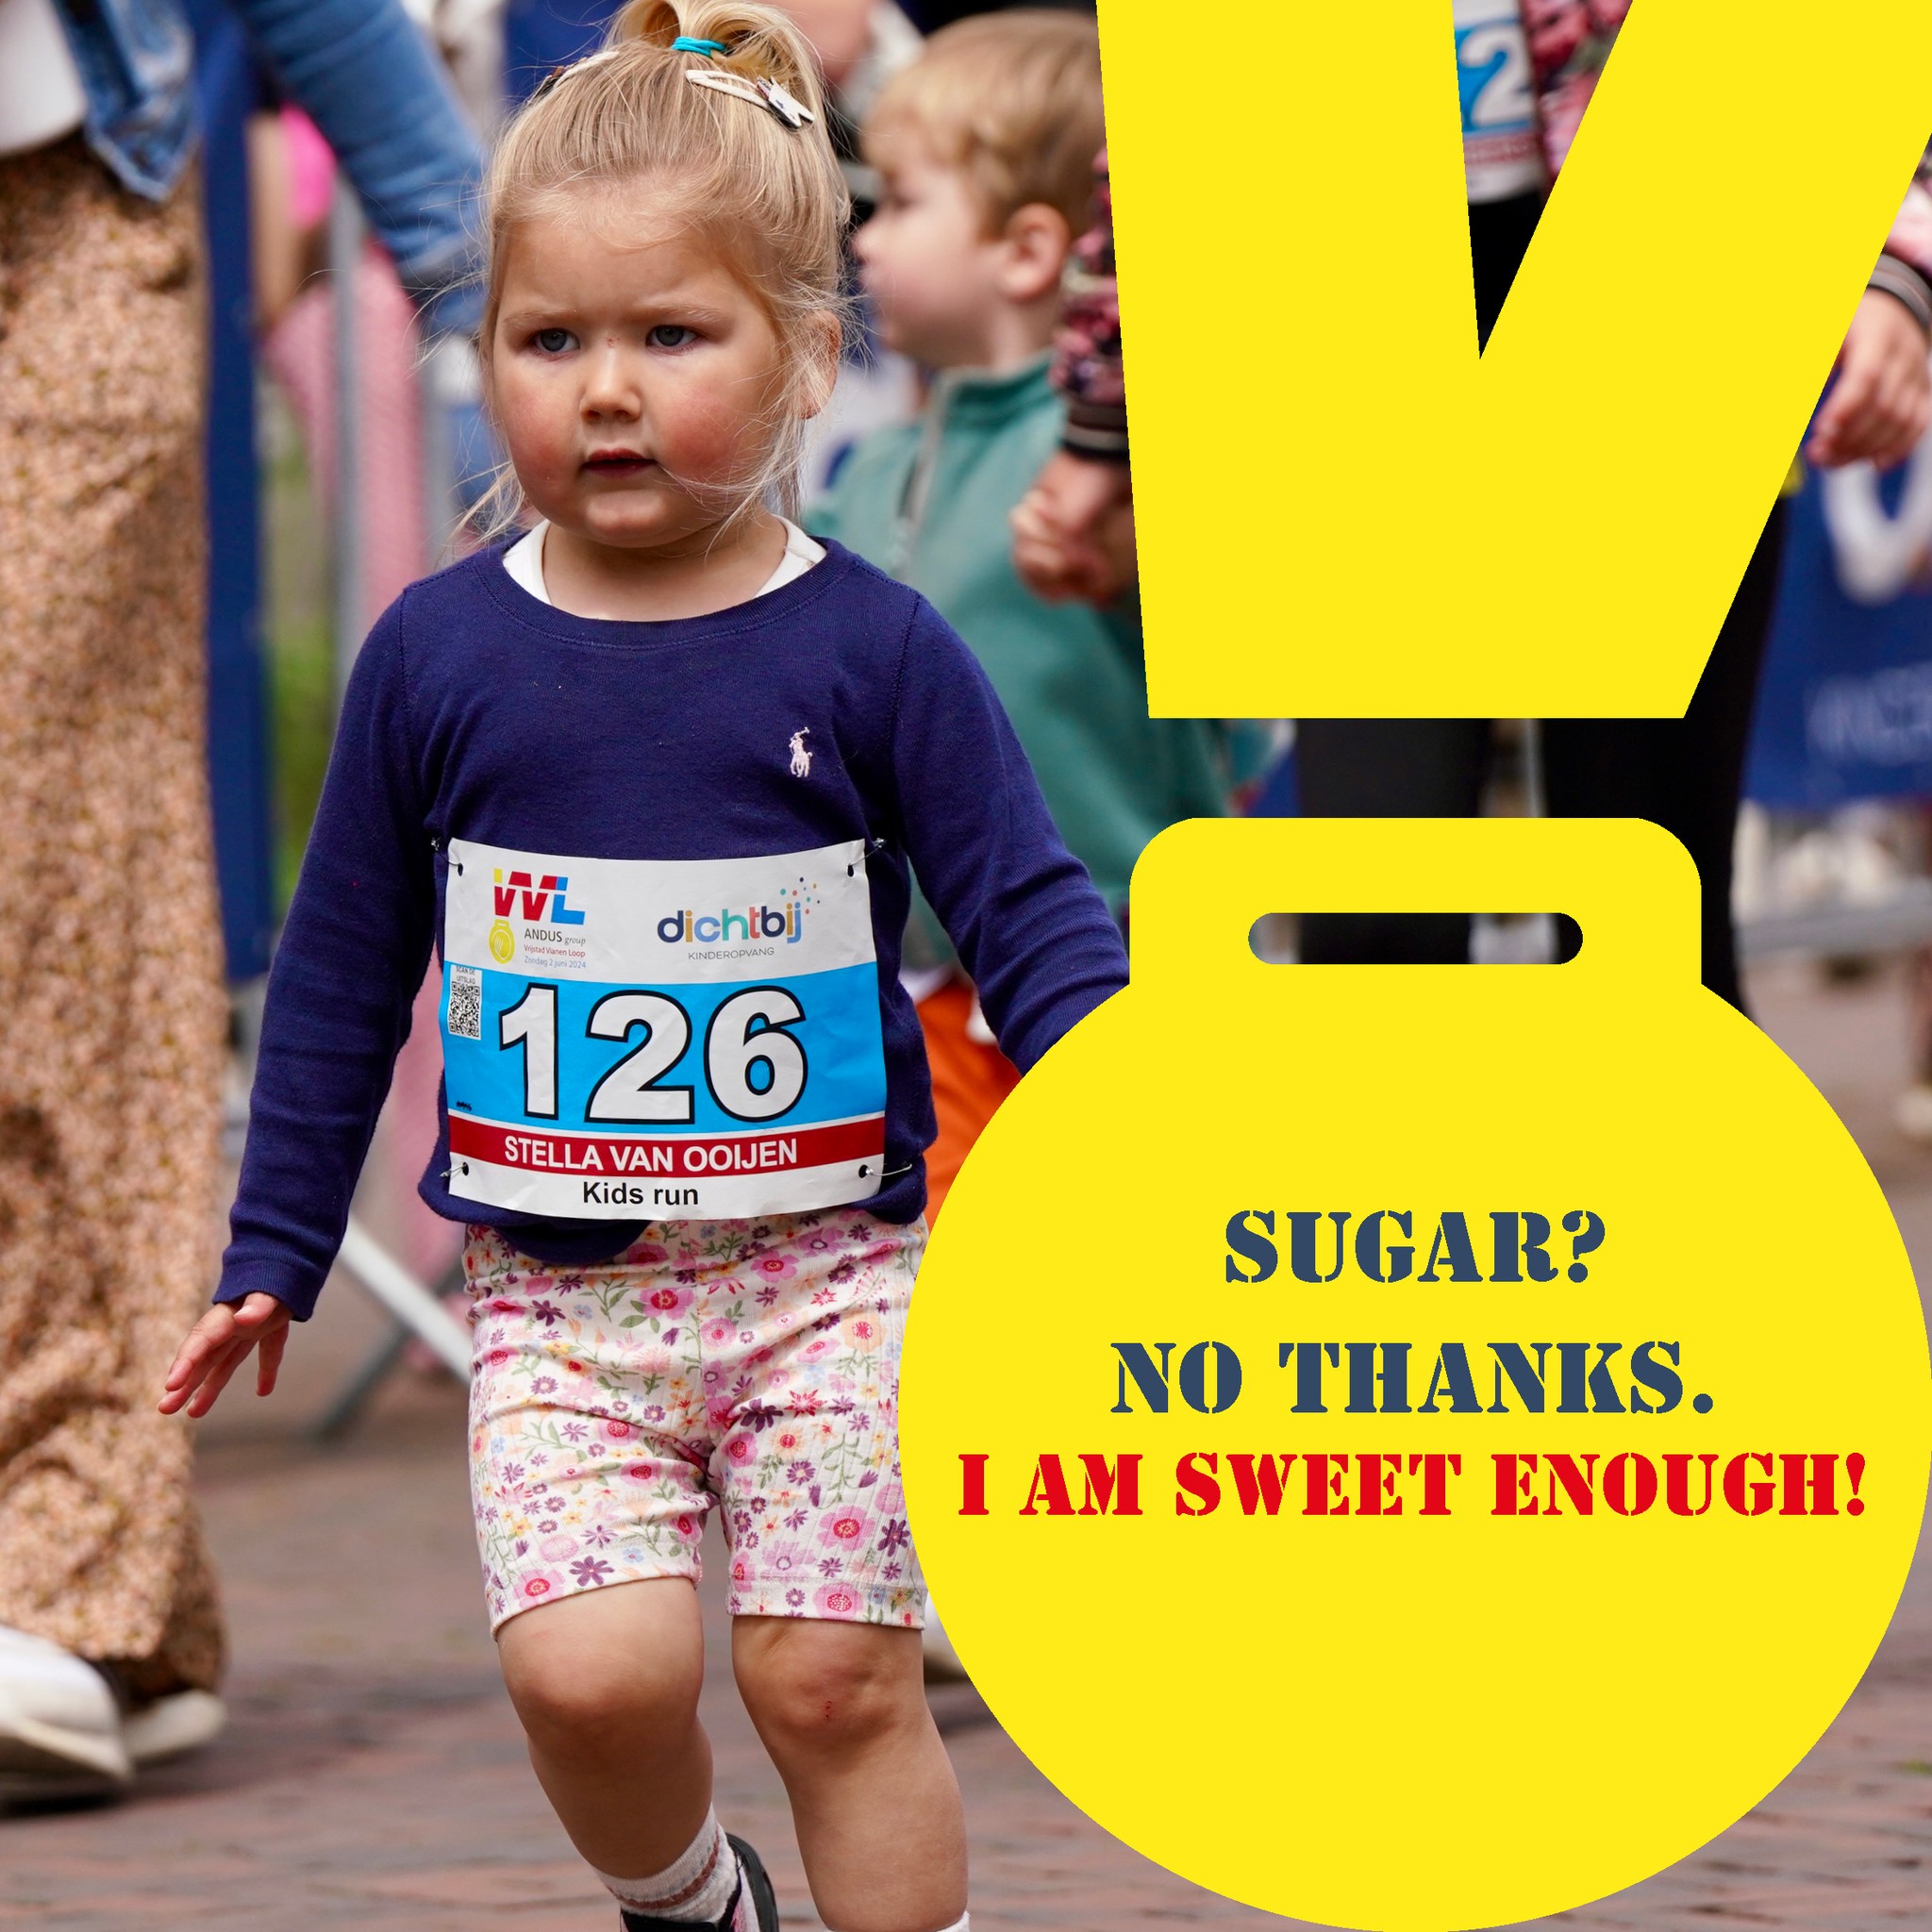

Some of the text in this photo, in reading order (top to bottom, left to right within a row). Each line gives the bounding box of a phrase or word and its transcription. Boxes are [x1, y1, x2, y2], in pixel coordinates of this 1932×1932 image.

[657, 901, 802, 944] dichtbij
[524, 928, 587, 947] ANDUS group
[524, 944, 586, 958] Vrijstad Vianen Loop
[688, 946, 775, 960] KINDEROPVANG
[524, 956, 548, 966] Zondag
[554, 958, 567, 968] juni
[568, 960, 587, 969] 2024
[499, 982, 808, 1124] 126
[505, 1135, 798, 1173] STELLA VAN OOIJEN
[582, 1180, 699, 1206] Kids run
